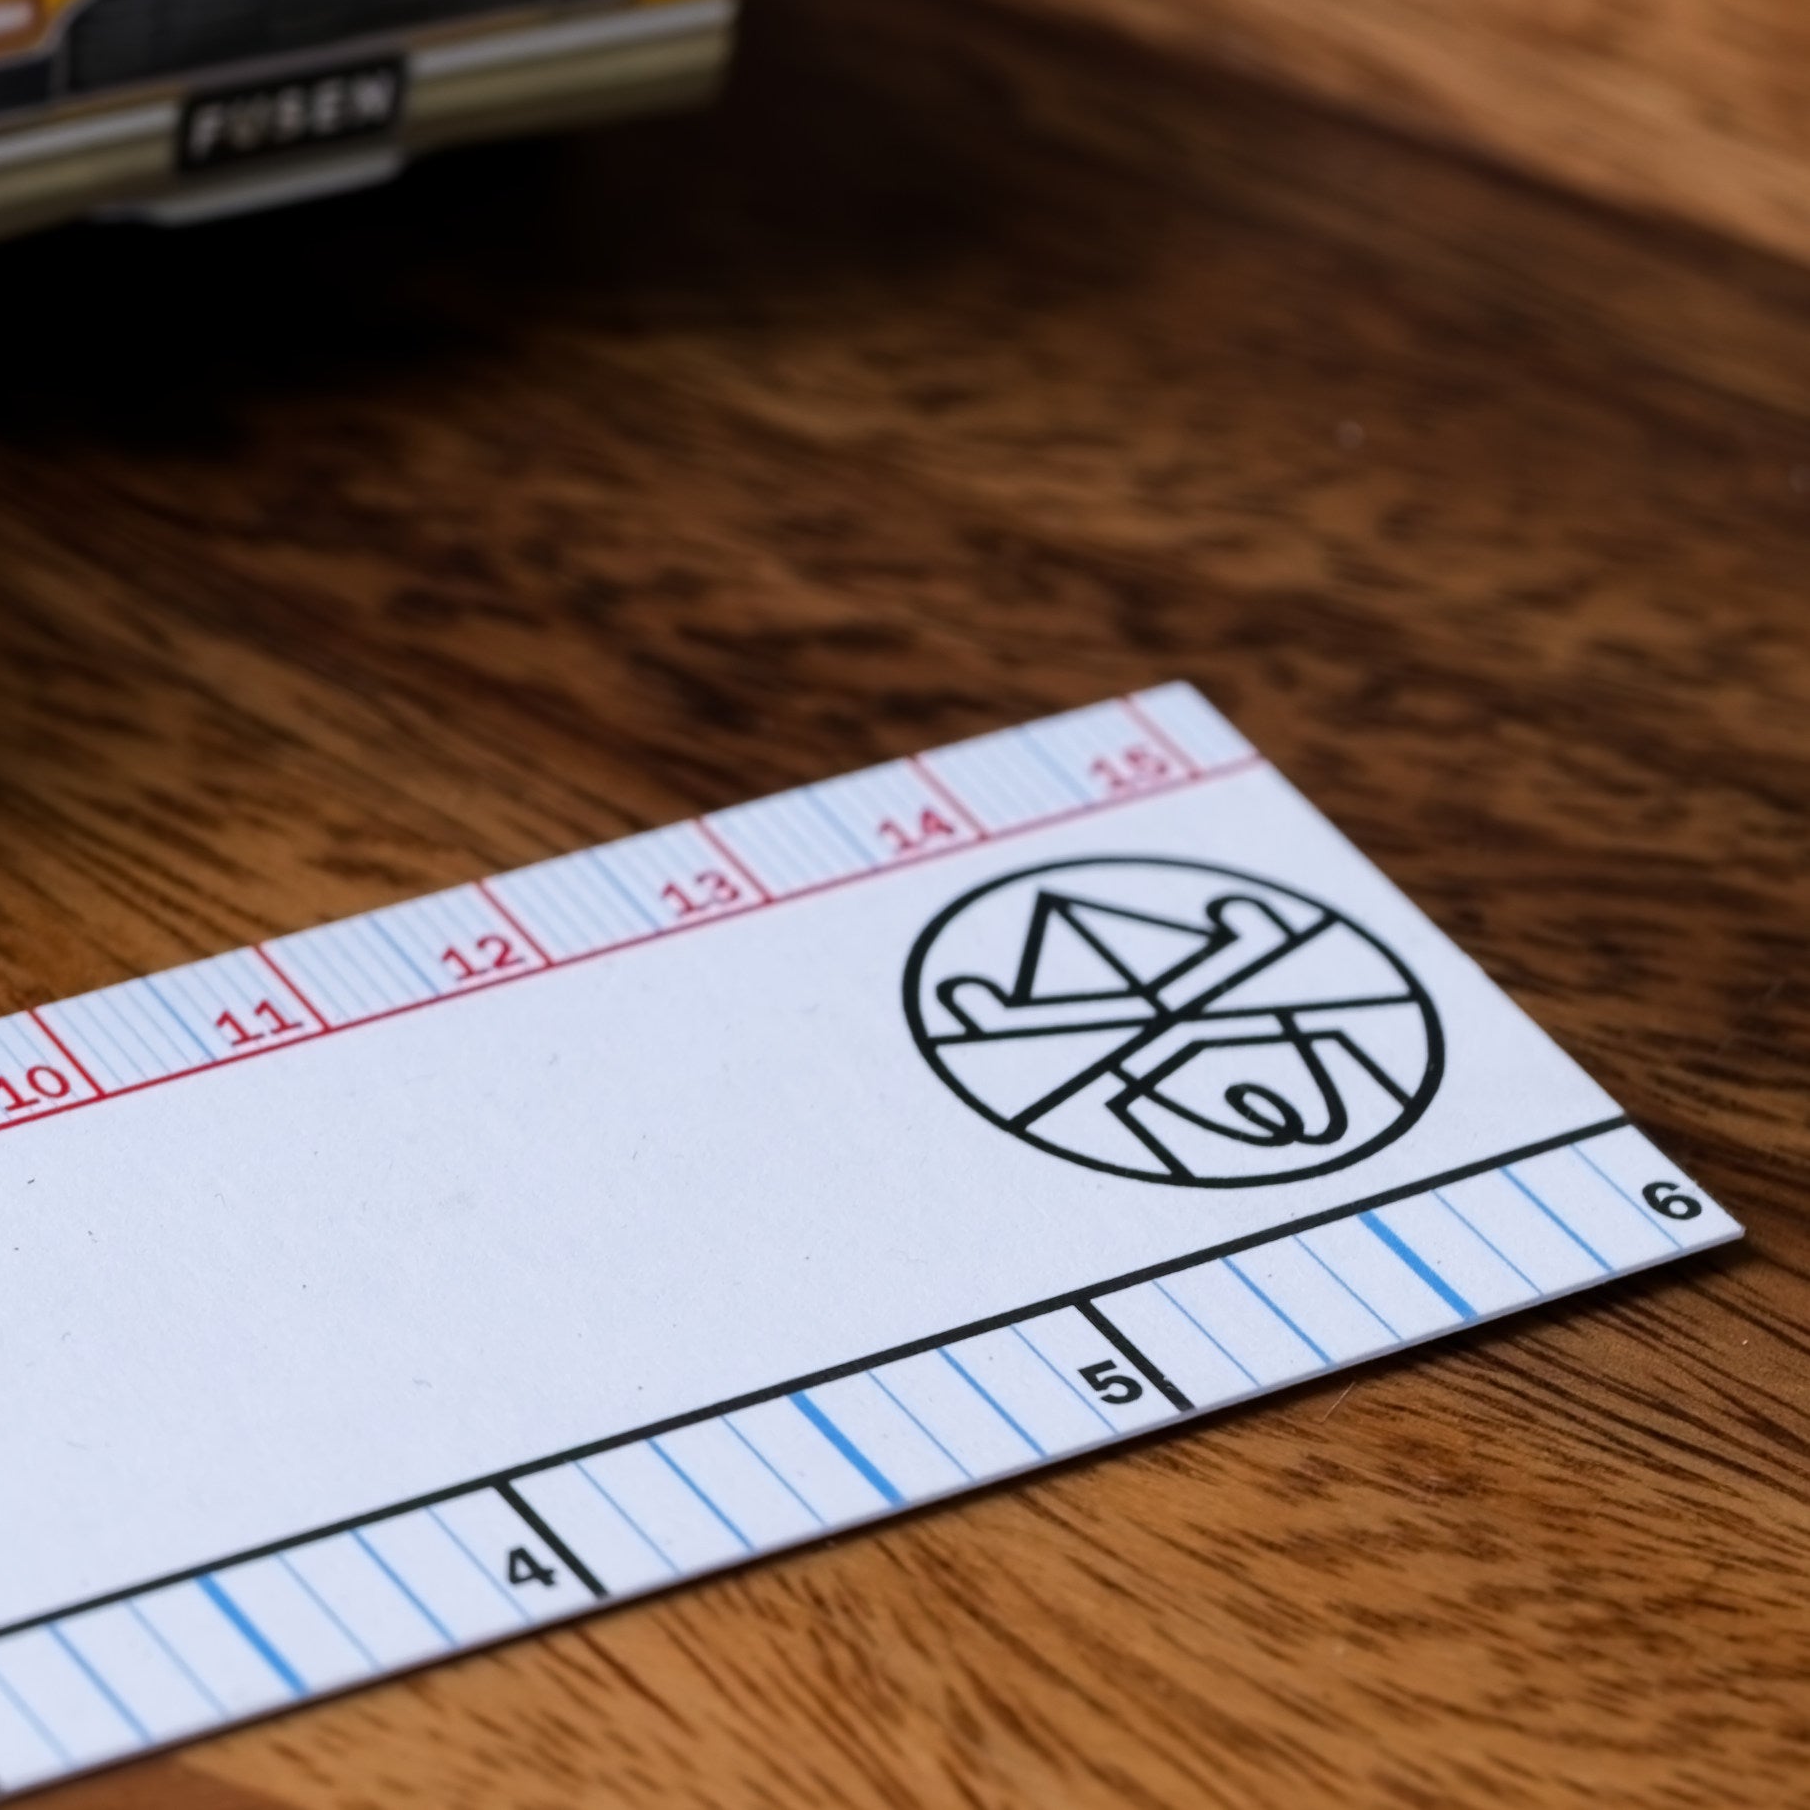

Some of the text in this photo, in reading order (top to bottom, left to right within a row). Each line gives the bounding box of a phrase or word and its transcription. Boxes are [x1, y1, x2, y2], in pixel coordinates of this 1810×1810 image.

[185, 70, 398, 163] FUSEN
[214, 1000, 303, 1047] 11
[442, 934, 525, 981] 12
[661, 868, 741, 918] 13
[878, 808, 956, 854] 14
[1090, 743, 1170, 792] 15
[504, 1546, 558, 1588] 4
[1079, 1359, 1143, 1406] 5
[1641, 1180, 1702, 1221] 6
